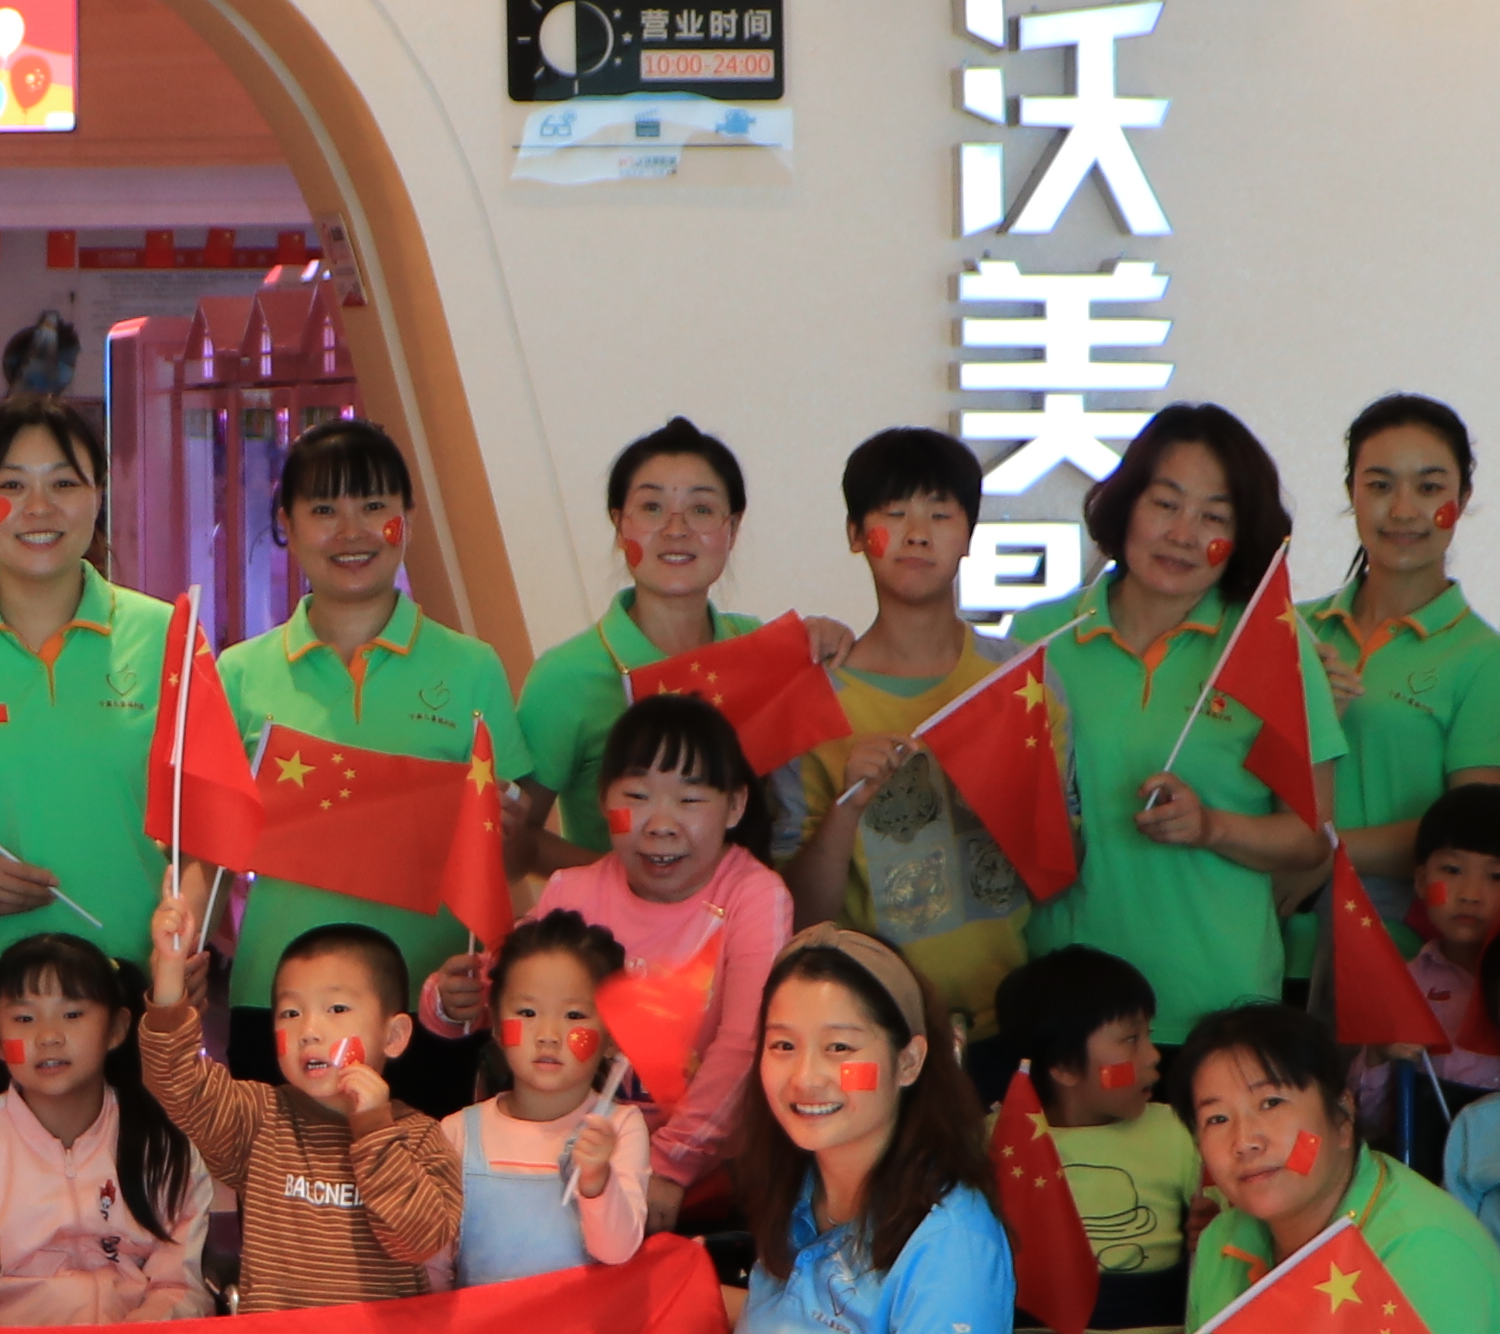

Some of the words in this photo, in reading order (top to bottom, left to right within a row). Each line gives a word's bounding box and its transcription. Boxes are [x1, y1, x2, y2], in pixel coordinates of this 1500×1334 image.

[640, 9, 774, 42] 营业时间
[643, 53, 773, 76] 10:00-24:00
